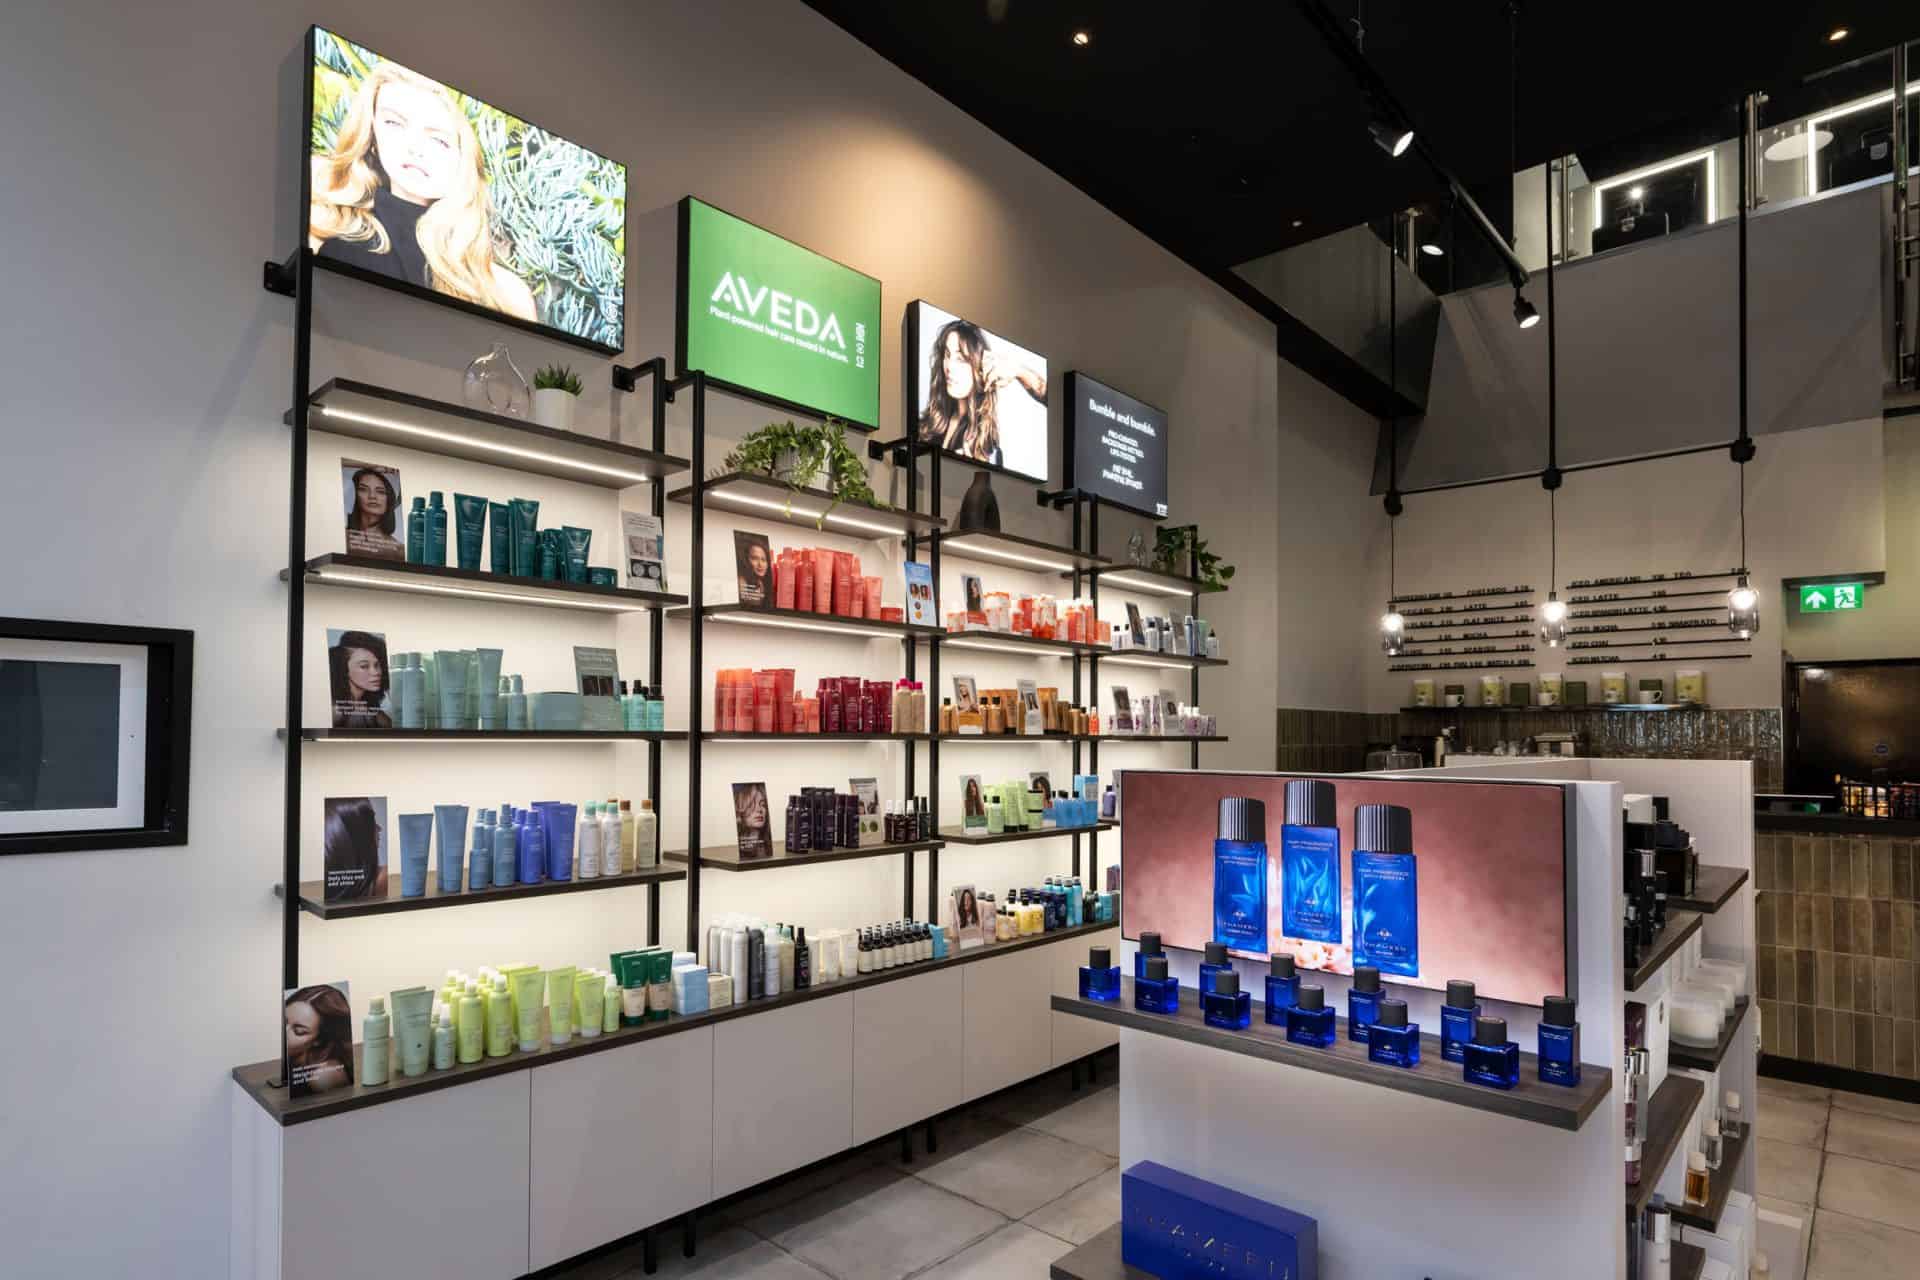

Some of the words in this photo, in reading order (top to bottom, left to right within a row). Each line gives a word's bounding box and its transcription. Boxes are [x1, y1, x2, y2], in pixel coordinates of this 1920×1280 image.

[711, 271, 847, 350] AVEDA
[1089, 398, 1116, 420] Bumble
[1116, 412, 1130, 427] and
